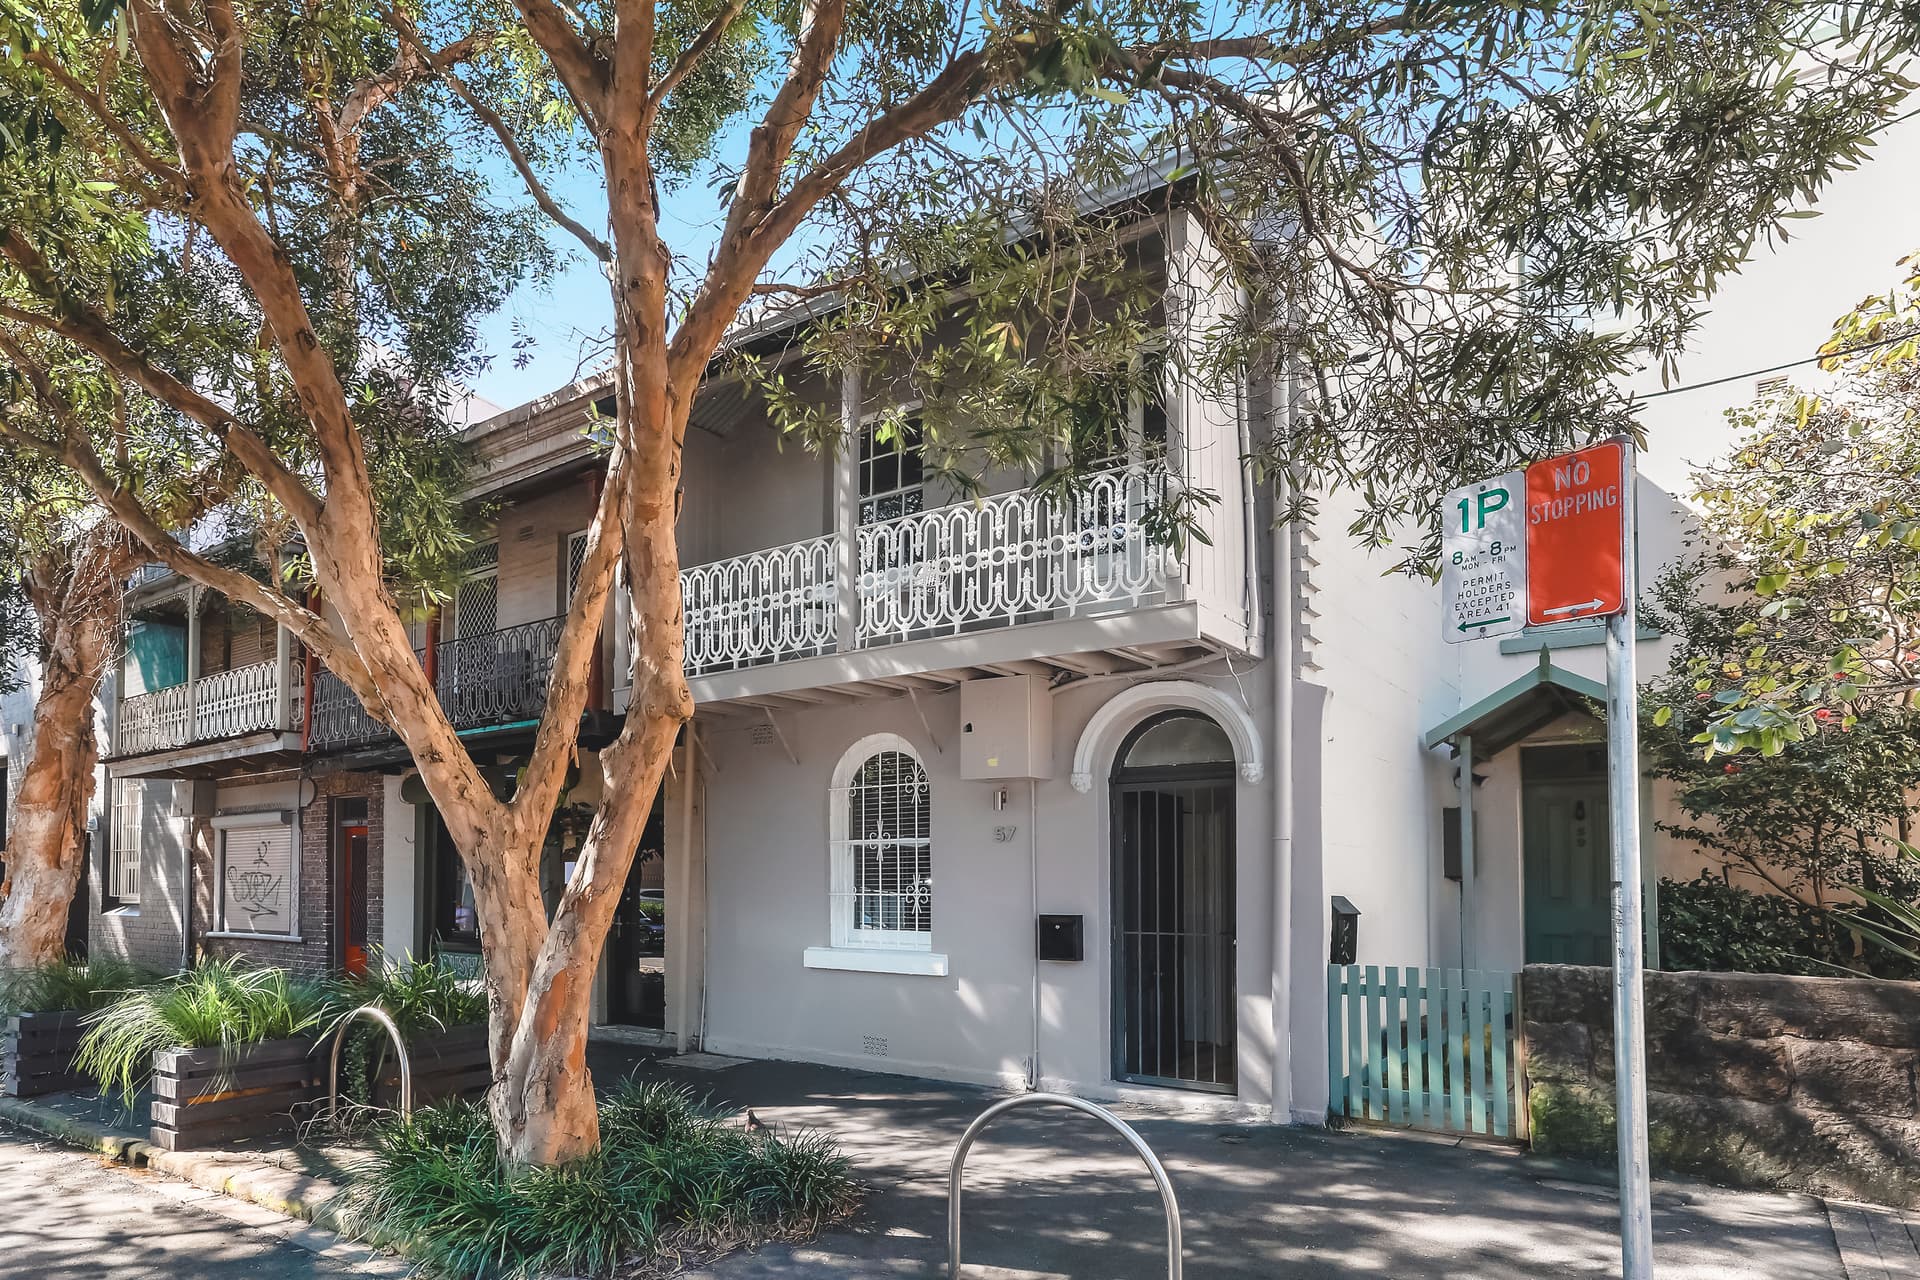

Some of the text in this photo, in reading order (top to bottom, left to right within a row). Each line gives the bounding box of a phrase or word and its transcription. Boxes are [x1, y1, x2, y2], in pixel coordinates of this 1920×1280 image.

[1555, 460, 1590, 492] NO
[1457, 488, 1510, 534] 1P
[1531, 485, 1617, 525] STOPPING
[1461, 562, 1480, 572] MON
[1491, 555, 1506, 565] FRI
[1463, 572, 1504, 589] PERMIT
[1457, 581, 1511, 601] HOLDERS
[1455, 592, 1515, 612] EXCEPTED
[1458, 603, 1510, 621] AREA 41
[993, 825, 1017, 842] 57
